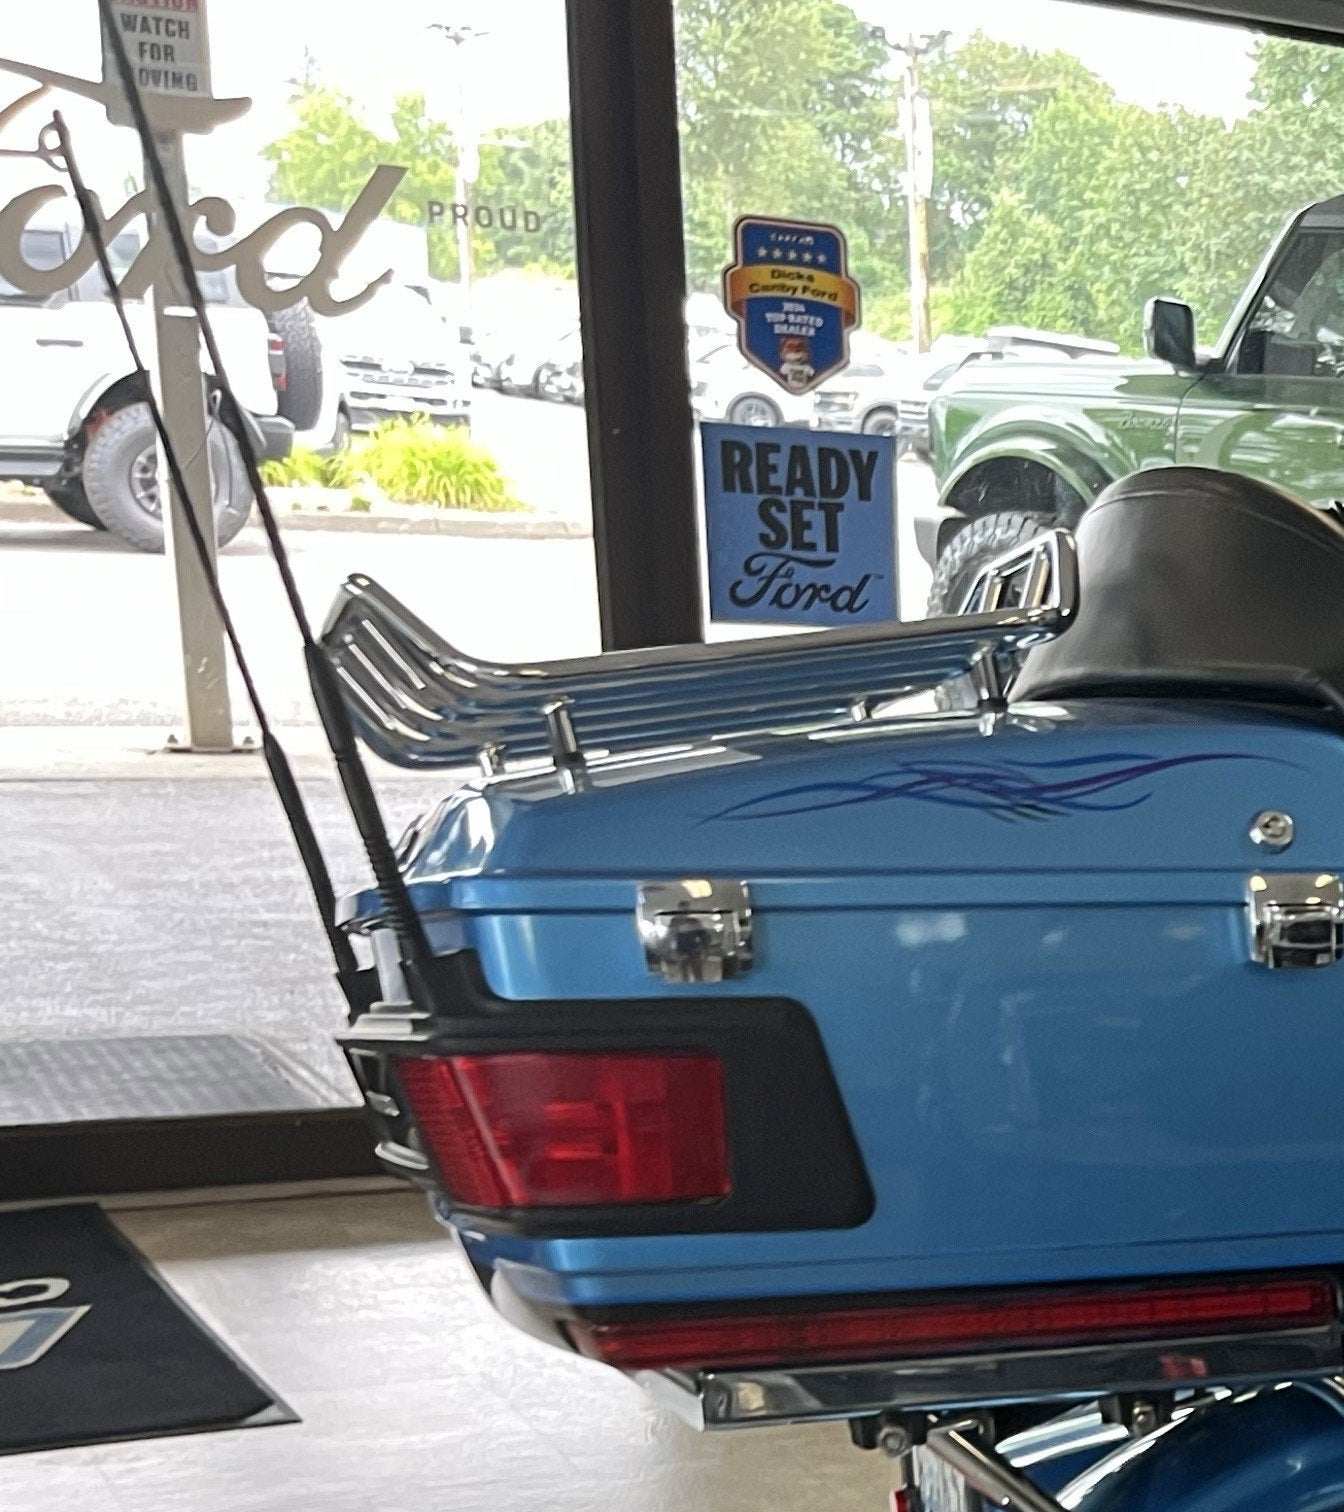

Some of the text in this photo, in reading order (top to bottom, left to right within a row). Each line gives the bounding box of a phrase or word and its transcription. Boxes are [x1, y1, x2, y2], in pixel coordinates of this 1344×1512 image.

[120, 13, 190, 39] WATCH
[138, 41, 175, 63] FOR
[137, 67, 198, 92] OVING
[427, 200, 543, 233] PROUD
[801, 286, 839, 302] Ford
[720, 439, 879, 502] READY
[757, 497, 845, 553] SET
[729, 551, 872, 613] Ford
